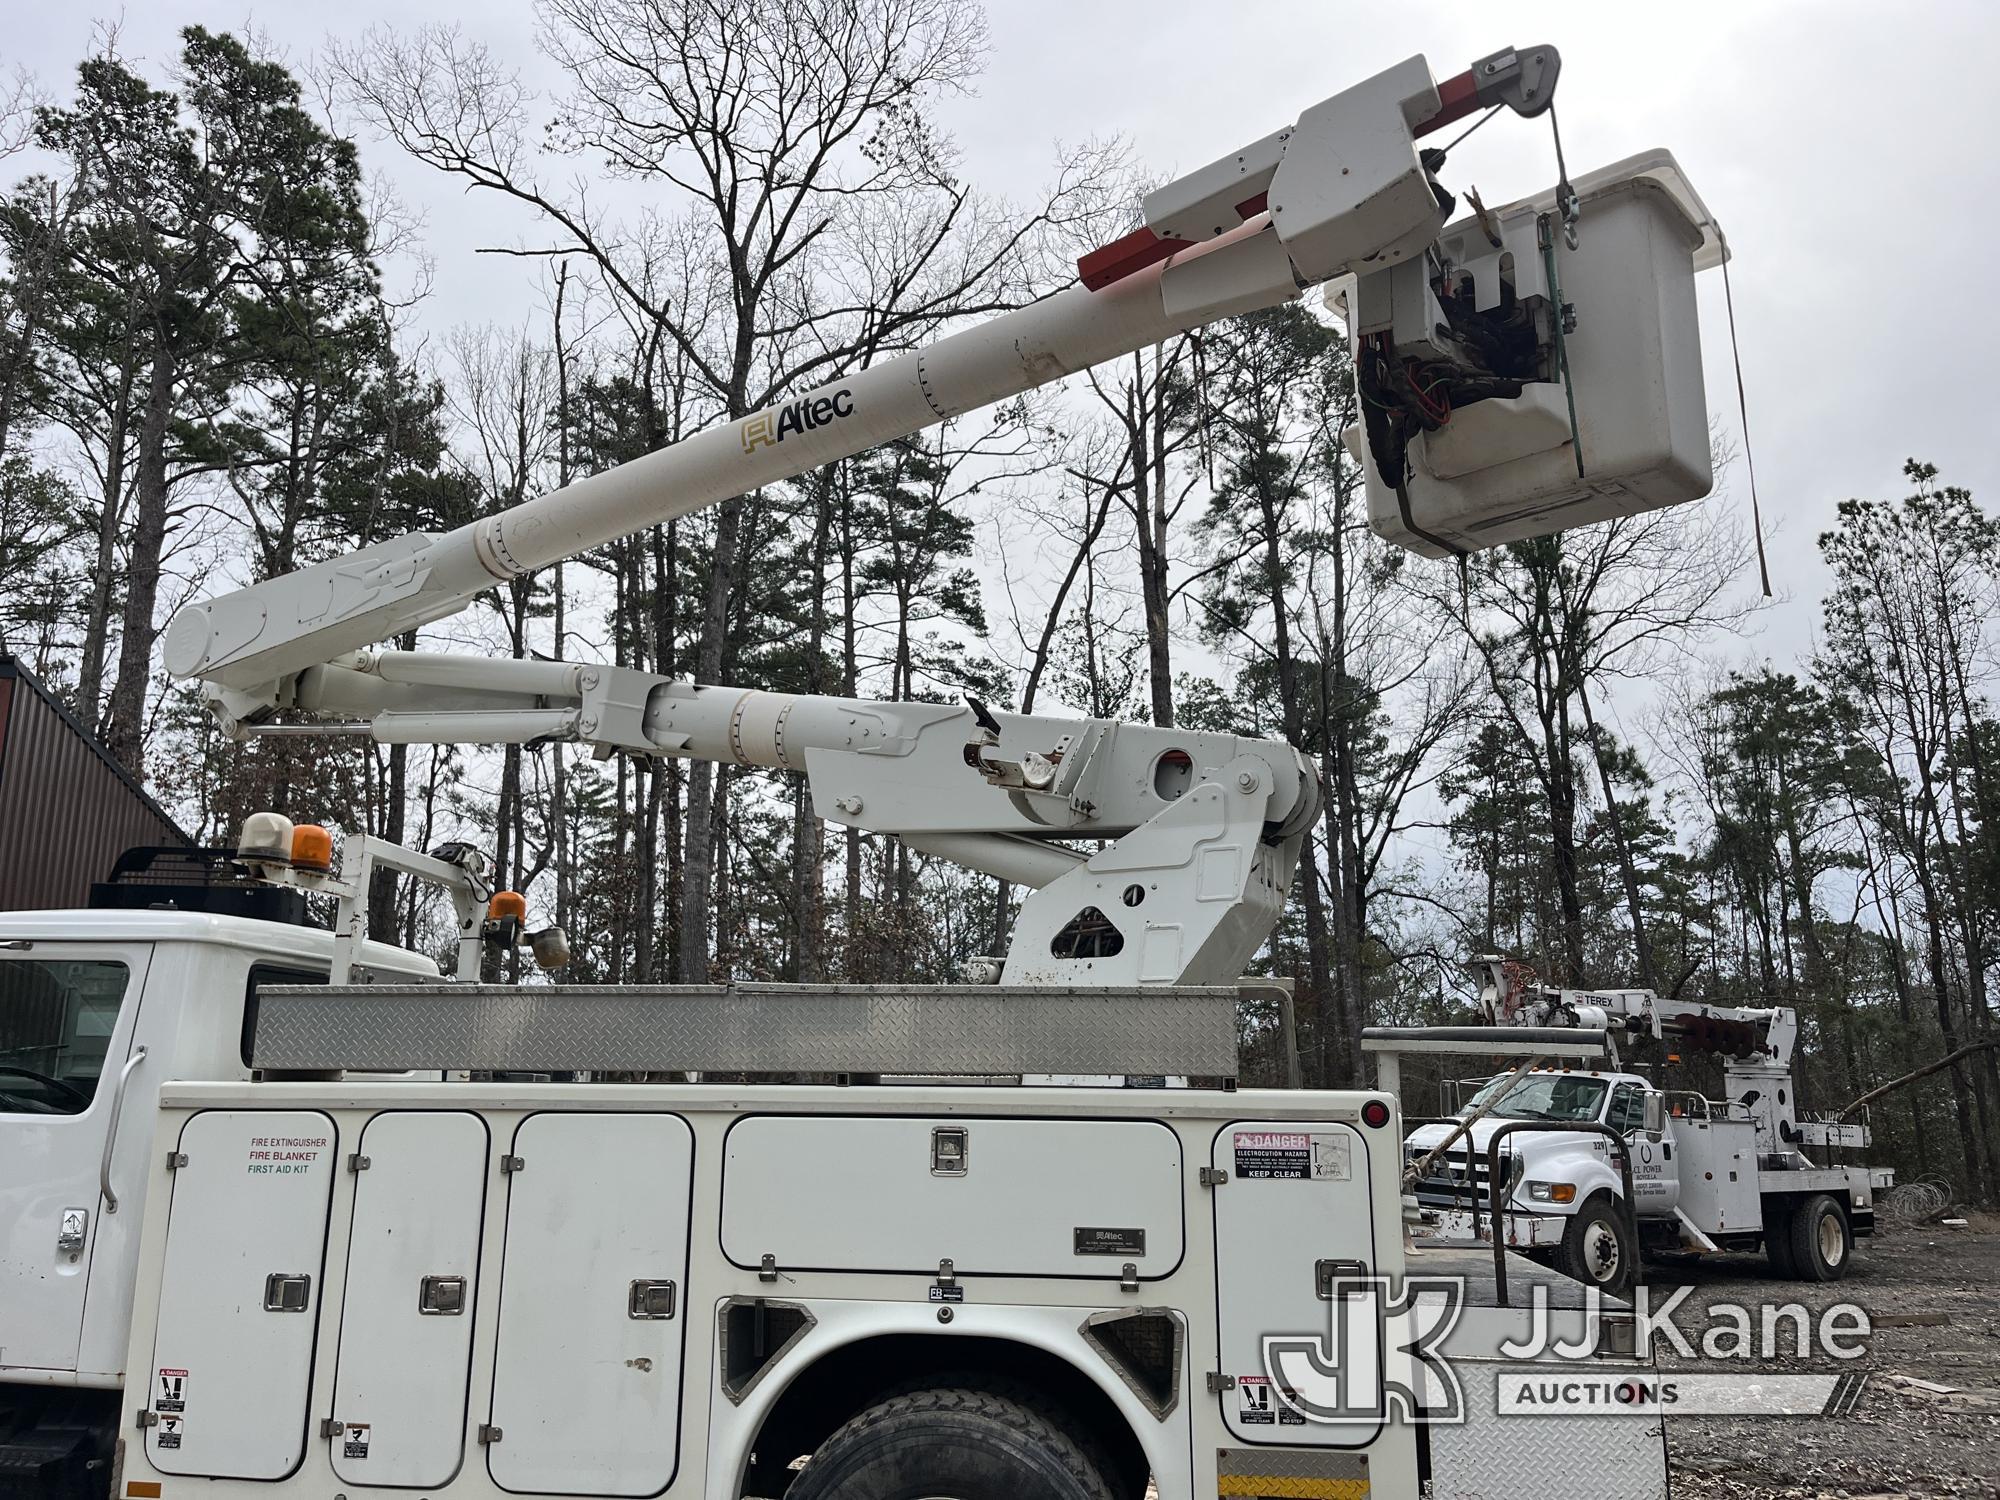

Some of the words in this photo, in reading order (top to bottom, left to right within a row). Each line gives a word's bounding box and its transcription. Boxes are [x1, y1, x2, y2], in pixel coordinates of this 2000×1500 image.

[777, 389, 854, 442] Altec
[1584, 995, 1614, 1008] TEREX
[251, 1138, 268, 1147] FIRE
[270, 1138, 327, 1147] EXTINGUISHER
[1254, 1135, 1307, 1148] DANGER
[249, 1151, 270, 1160] FIRE
[273, 1152, 318, 1160] BLANKET
[248, 1165, 274, 1173] FIRST
[275, 1165, 292, 1173] AID
[293, 1165, 309, 1173] KIT
[1643, 1165, 1663, 1173] POWER
[1248, 1170, 1270, 1178] KEEP
[1273, 1170, 1301, 1178] CLEAR
[1104, 1231, 1123, 1240] Altec
